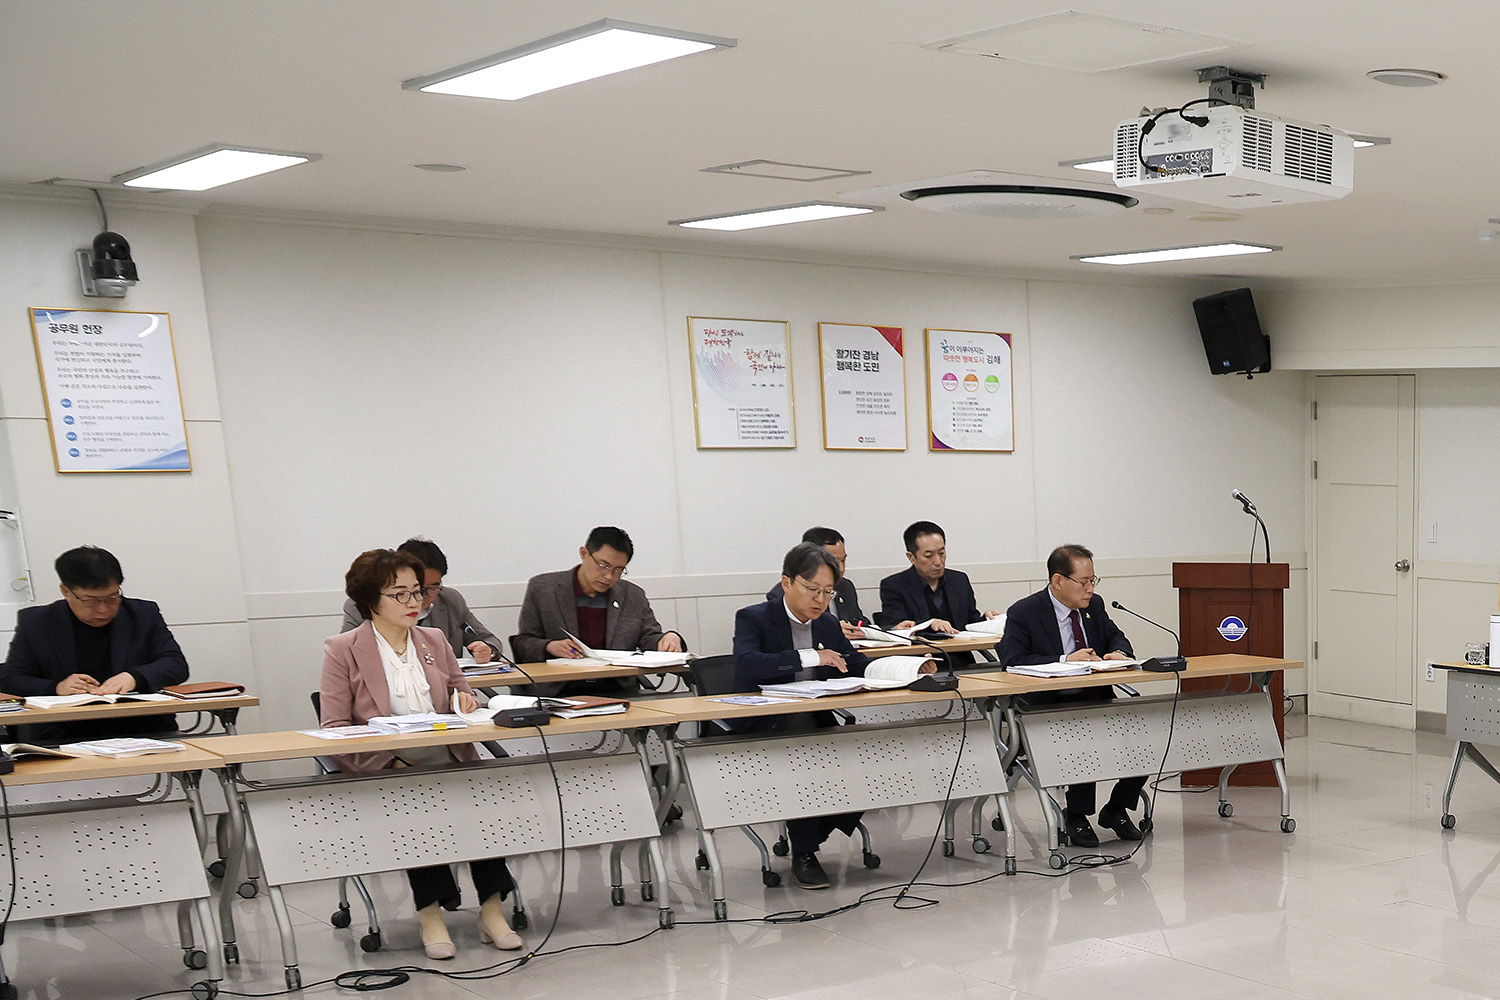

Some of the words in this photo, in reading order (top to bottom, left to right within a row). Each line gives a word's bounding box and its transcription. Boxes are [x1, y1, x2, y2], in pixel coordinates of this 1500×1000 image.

[48, 323, 79, 335] 공무원
[82, 324, 103, 335] 헌장
[836, 348, 861, 360] 활기찬
[862, 349, 880, 360] 경남
[986, 354, 1001, 365] 김해
[836, 361, 861, 372] 행복한
[862, 361, 880, 373] 도민
